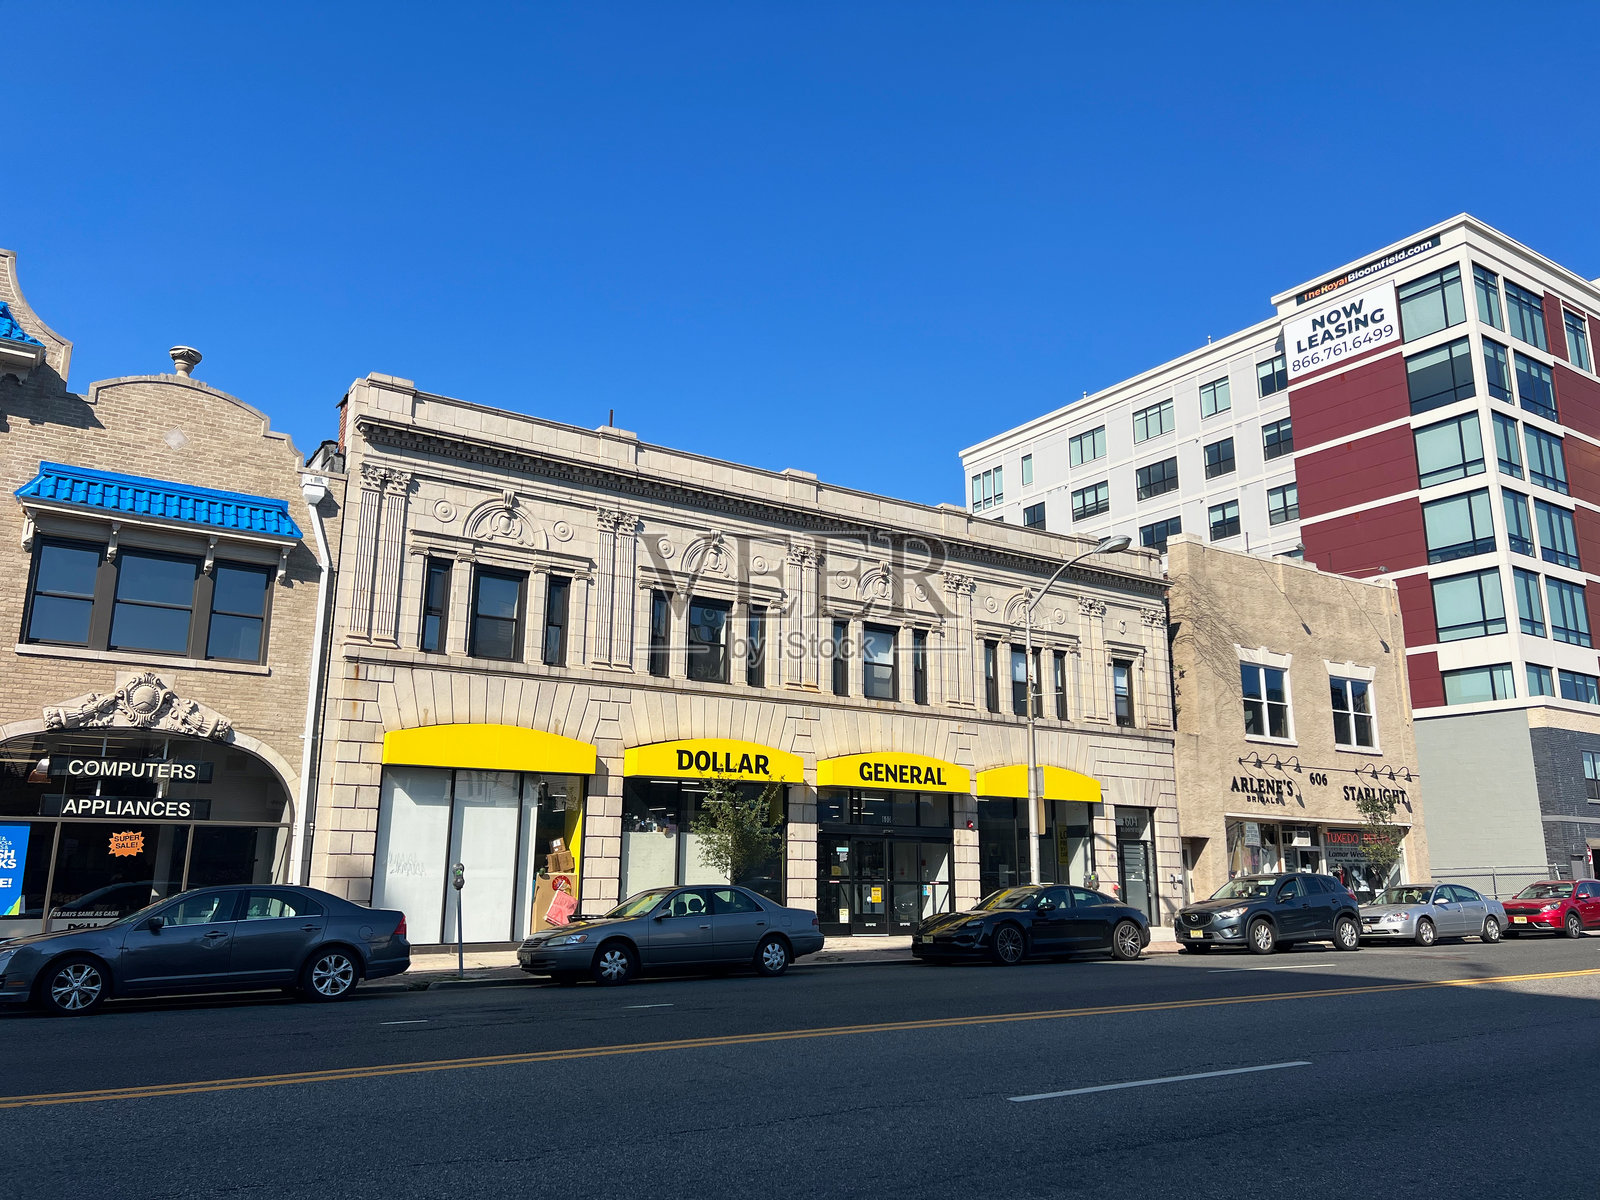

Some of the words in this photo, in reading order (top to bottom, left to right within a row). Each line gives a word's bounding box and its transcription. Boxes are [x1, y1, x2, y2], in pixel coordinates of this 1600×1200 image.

[1303, 240, 1433, 301] TheRoyalBloomfield.com
[1311, 298, 1364, 332] NOW
[1296, 308, 1385, 354] LEASING
[1292, 324, 1394, 372] 866.761.6499
[68, 759, 196, 779] COMPUTERS
[676, 749, 770, 775] DOLLAR
[858, 762, 947, 786] GENERAL
[1309, 772, 1328, 786] 606
[1230, 776, 1294, 797] ARLENE'S
[1343, 785, 1408, 804] STARLIGHT
[62, 799, 191, 817] APPLIANCES
[1246, 796, 1280, 804] BRIDALS
[115, 841, 138, 849] SALE!
[1326, 832, 1359, 844] TUXEDO
